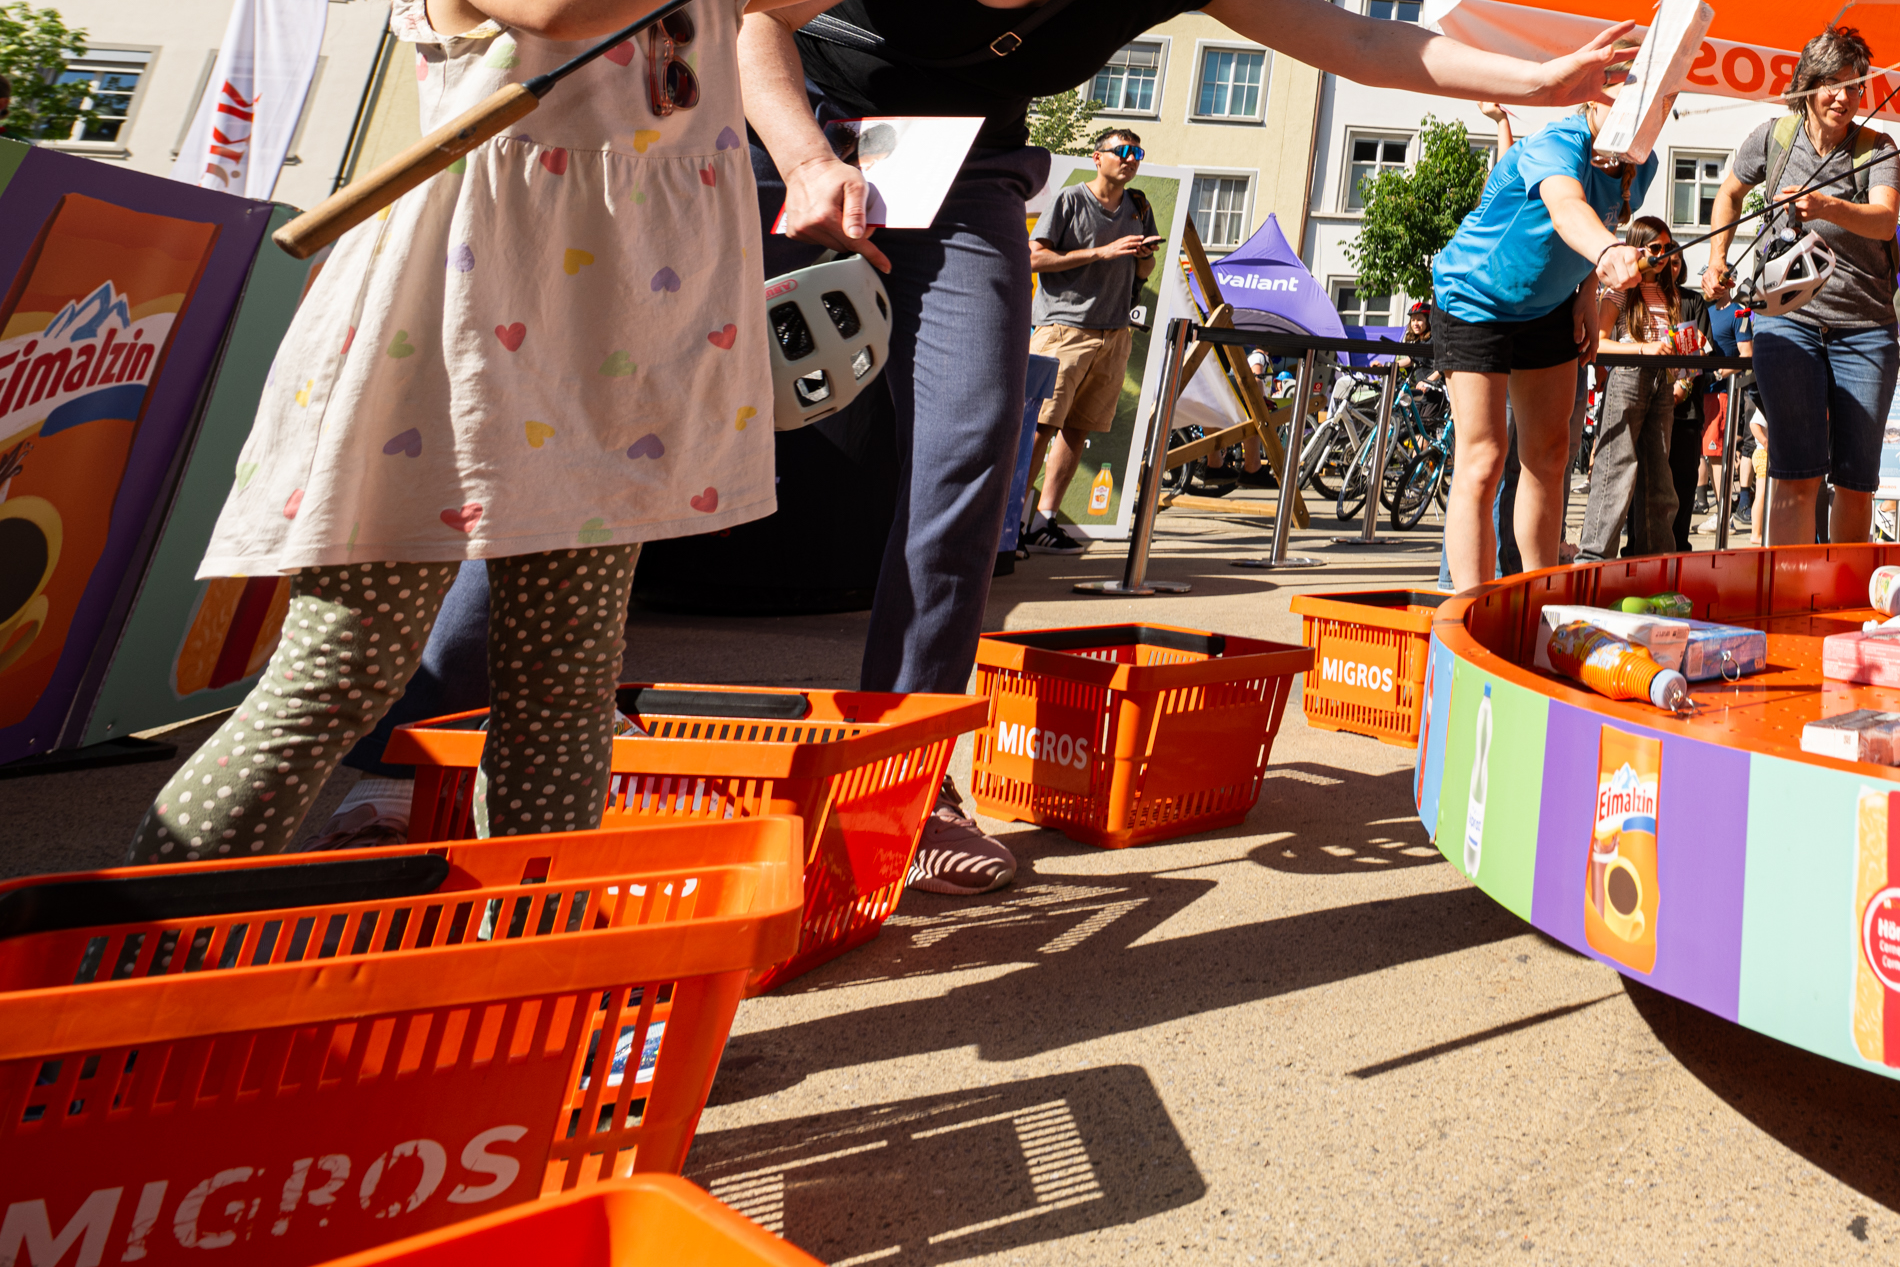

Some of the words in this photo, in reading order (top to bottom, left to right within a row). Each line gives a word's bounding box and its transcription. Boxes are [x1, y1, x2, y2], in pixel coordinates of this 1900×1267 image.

[1217, 272, 1299, 292] valiant
[1323, 657, 1393, 692] MIGROS
[998, 721, 1088, 769] MIGROS
[1599, 787, 1653, 822] Eimalzin
[0, 1125, 528, 1267] MIGROS
